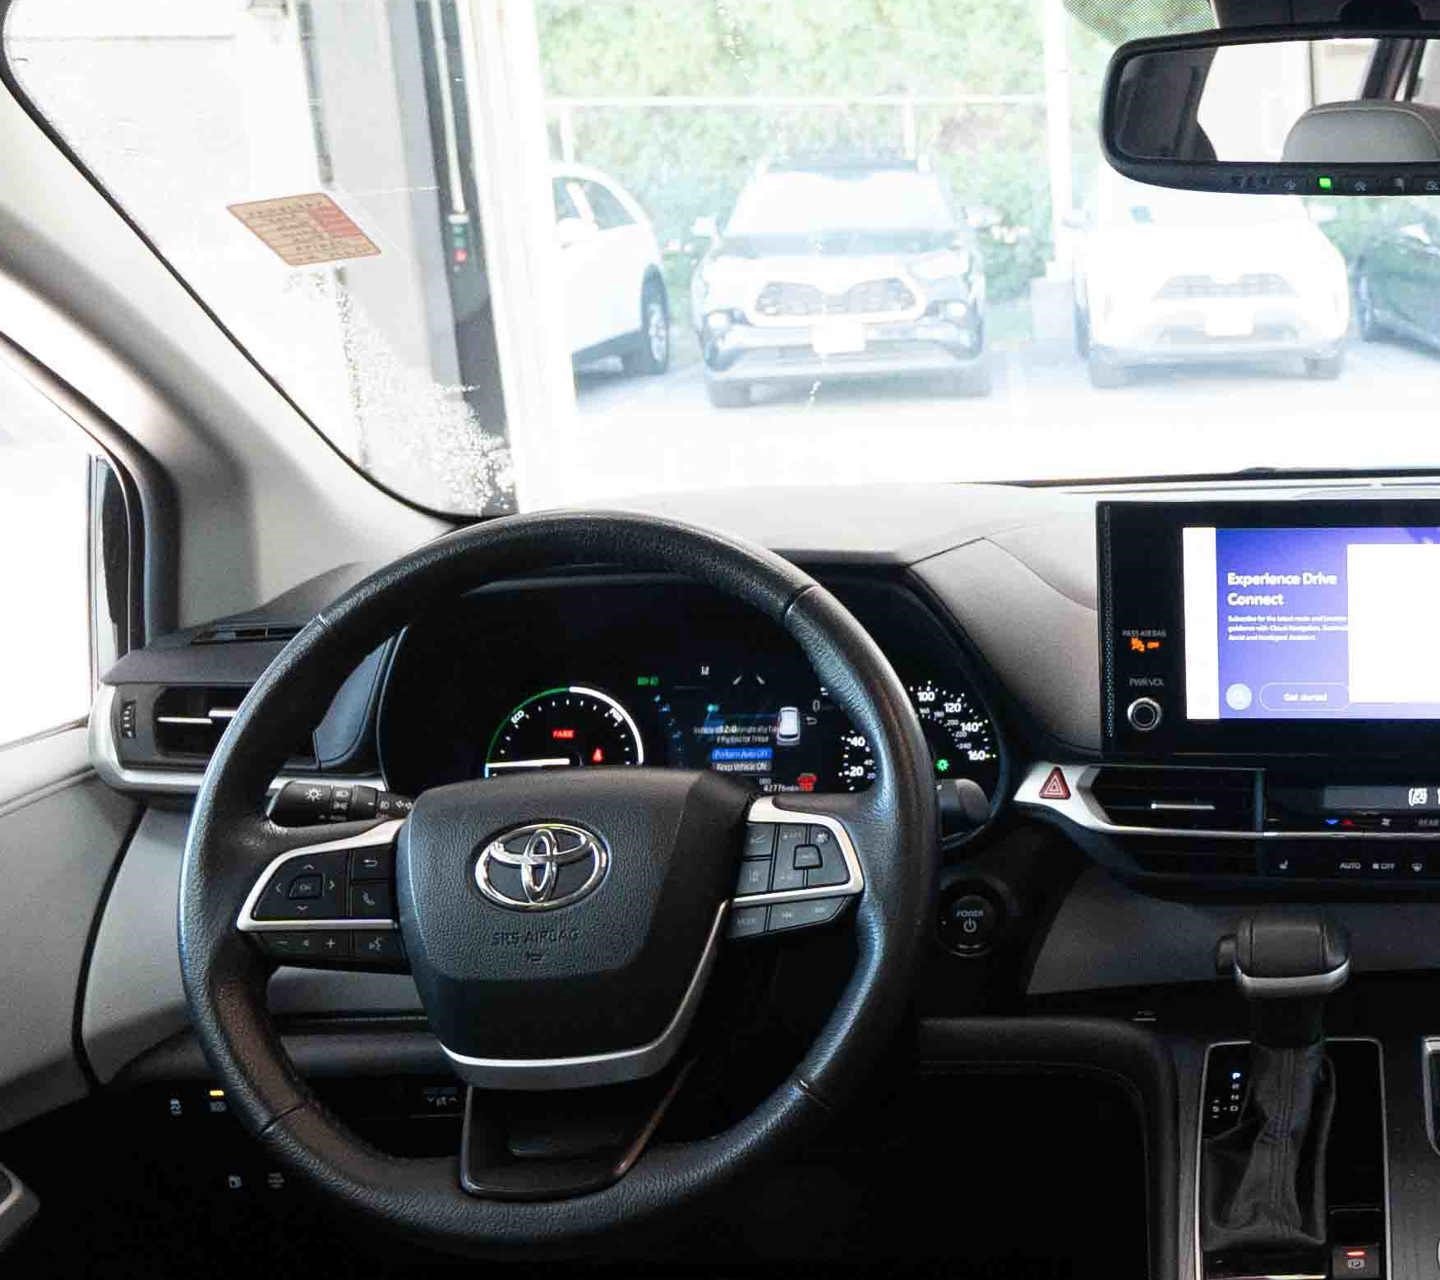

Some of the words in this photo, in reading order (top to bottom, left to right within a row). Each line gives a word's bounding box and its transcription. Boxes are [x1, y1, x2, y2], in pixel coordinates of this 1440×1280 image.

[1227, 573, 1301, 587] Experience
[1303, 572, 1337, 585] Drive
[1227, 593, 1284, 606] Connect
[917, 691, 935, 702] 100
[944, 702, 961, 713] 120
[960, 722, 978, 732] 140
[850, 737, 866, 747] 40
[968, 751, 985, 761] 160
[849, 766, 864, 776] 20
[1339, 862, 1362, 870] AUTO
[1380, 862, 1395, 870] OFF
[1232, 1072, 1241, 1080] P
